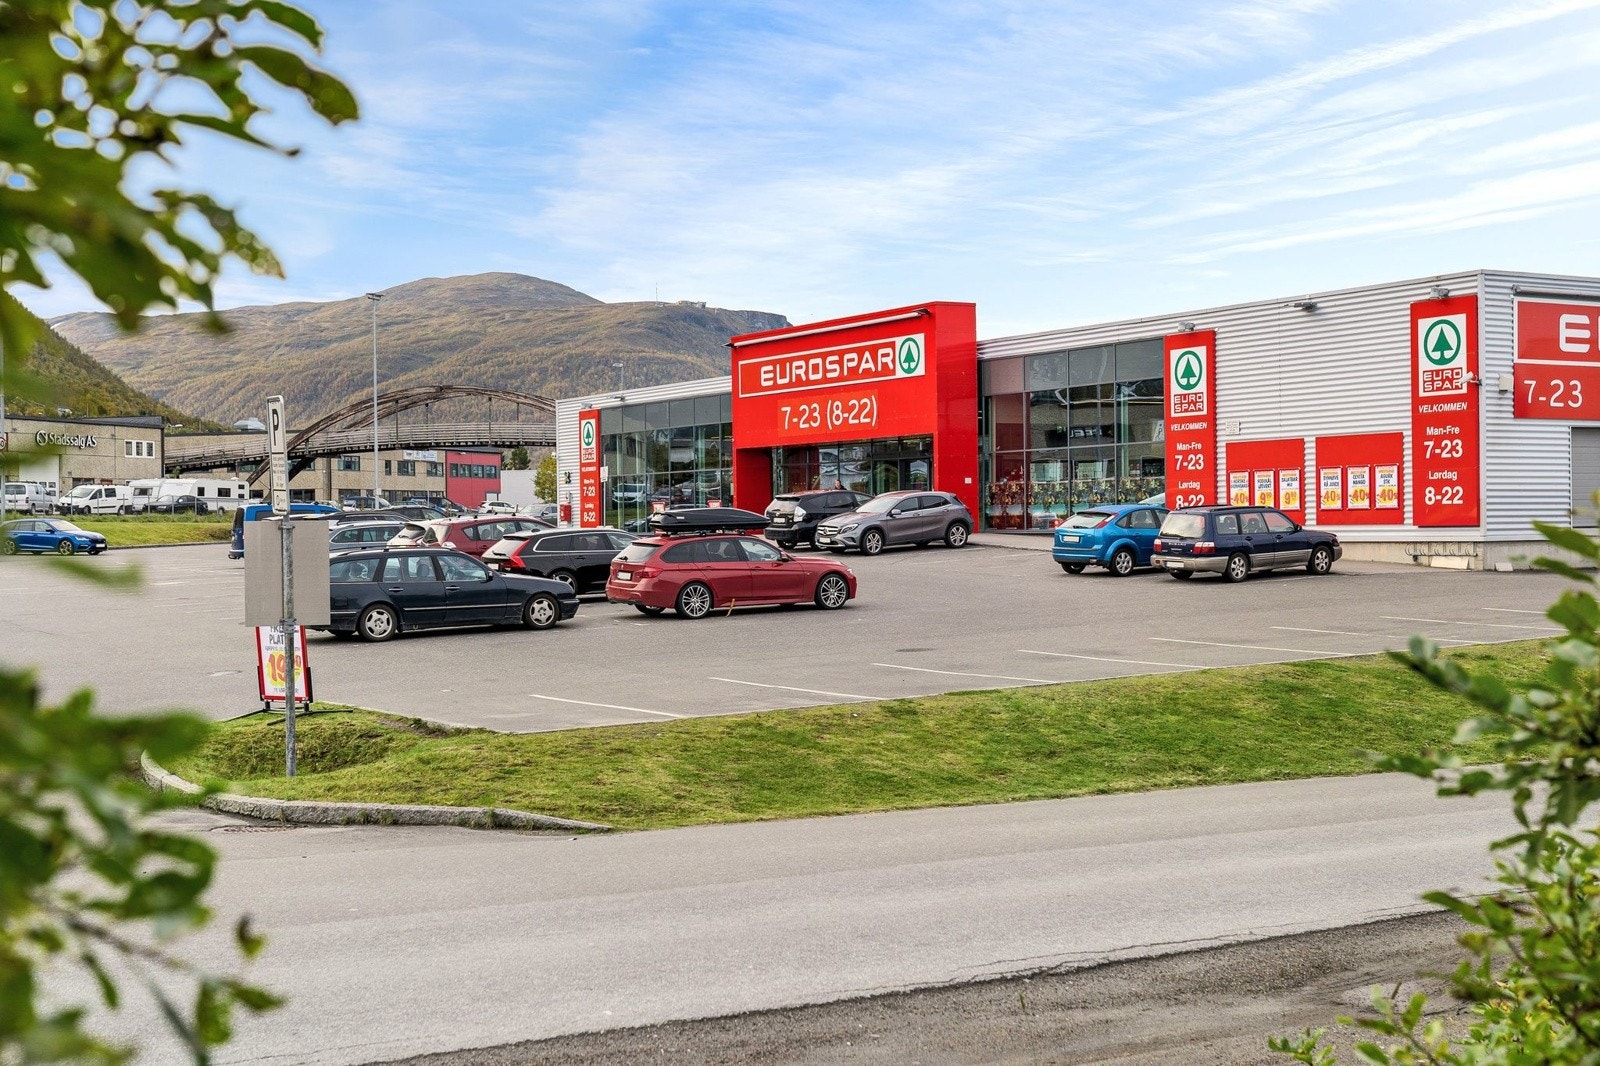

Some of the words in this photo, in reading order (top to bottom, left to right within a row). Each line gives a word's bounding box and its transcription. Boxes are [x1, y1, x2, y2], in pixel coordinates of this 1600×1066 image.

[1559, 313, 1600, 353] E
[760, 347, 894, 387] EUROSPAR
[1423, 369, 1463, 381] EURO
[1424, 380, 1462, 392] SPAR
[1174, 393, 1203, 404] EURO
[1523, 379, 1583, 408] 7-23
[781, 402, 821, 430] 7-23
[826, 395, 878, 430] (8-22)
[1174, 403, 1203, 413] SPAR
[1418, 402, 1468, 414] VELKOMMEN
[1170, 421, 1208, 432] VELKOMMEN
[1426, 426, 1460, 436] Man-Fre
[49, 432, 86, 449] Stadssalg
[86, 434, 98, 448] AS
[1176, 441, 1202, 451] Man-Fre
[1423, 439, 1463, 459] 7-23
[1174, 453, 1204, 471] 7-23
[1428, 470, 1458, 481] Lørdag
[1178, 480, 1201, 490] Lørdag
[583, 486, 596, 497] 7-23
[1424, 486, 1464, 505] 8-22
[1176, 494, 1205, 509] 8-22
